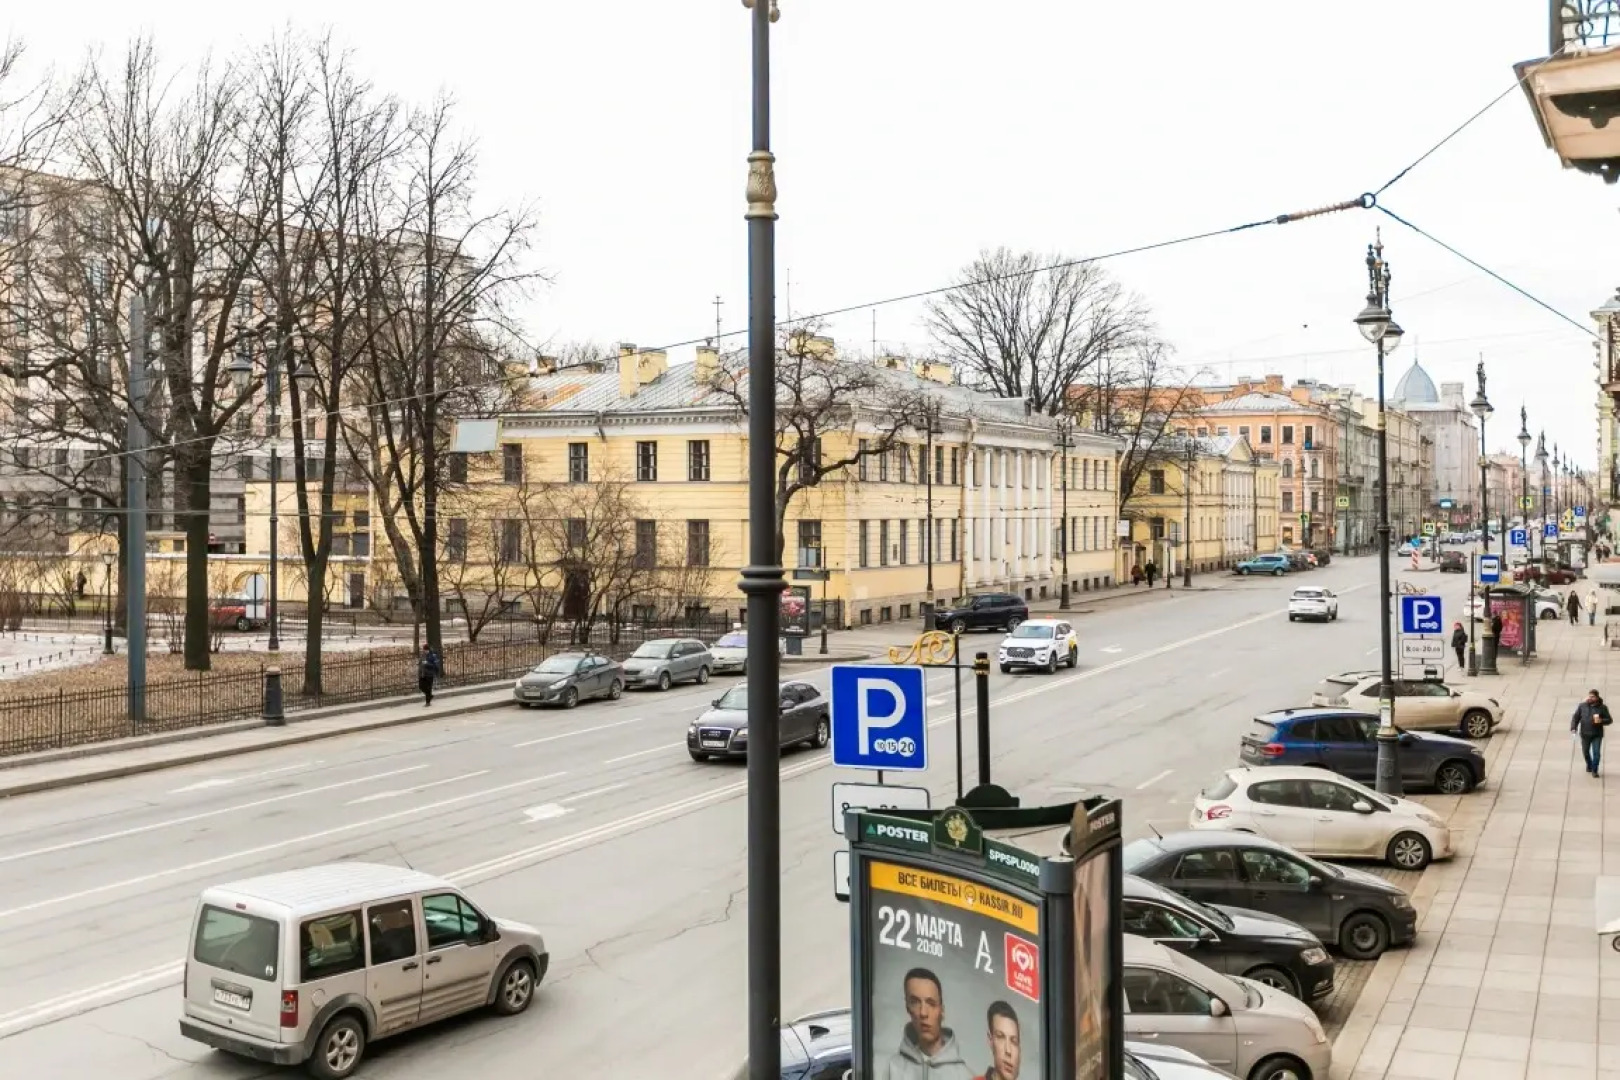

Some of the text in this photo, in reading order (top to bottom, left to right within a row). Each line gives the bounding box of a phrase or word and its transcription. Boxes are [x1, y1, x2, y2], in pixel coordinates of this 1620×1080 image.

[1412, 600, 1434, 630] P
[857, 677, 907, 755] P
[900, 740, 915, 753] 20
[876, 823, 929, 843] POSTER
[898, 871, 962, 898] ВСЕ БИЛЕТЫ
[878, 905, 964, 950] 22 МАРТА
[916, 937, 943, 957] 20:00
